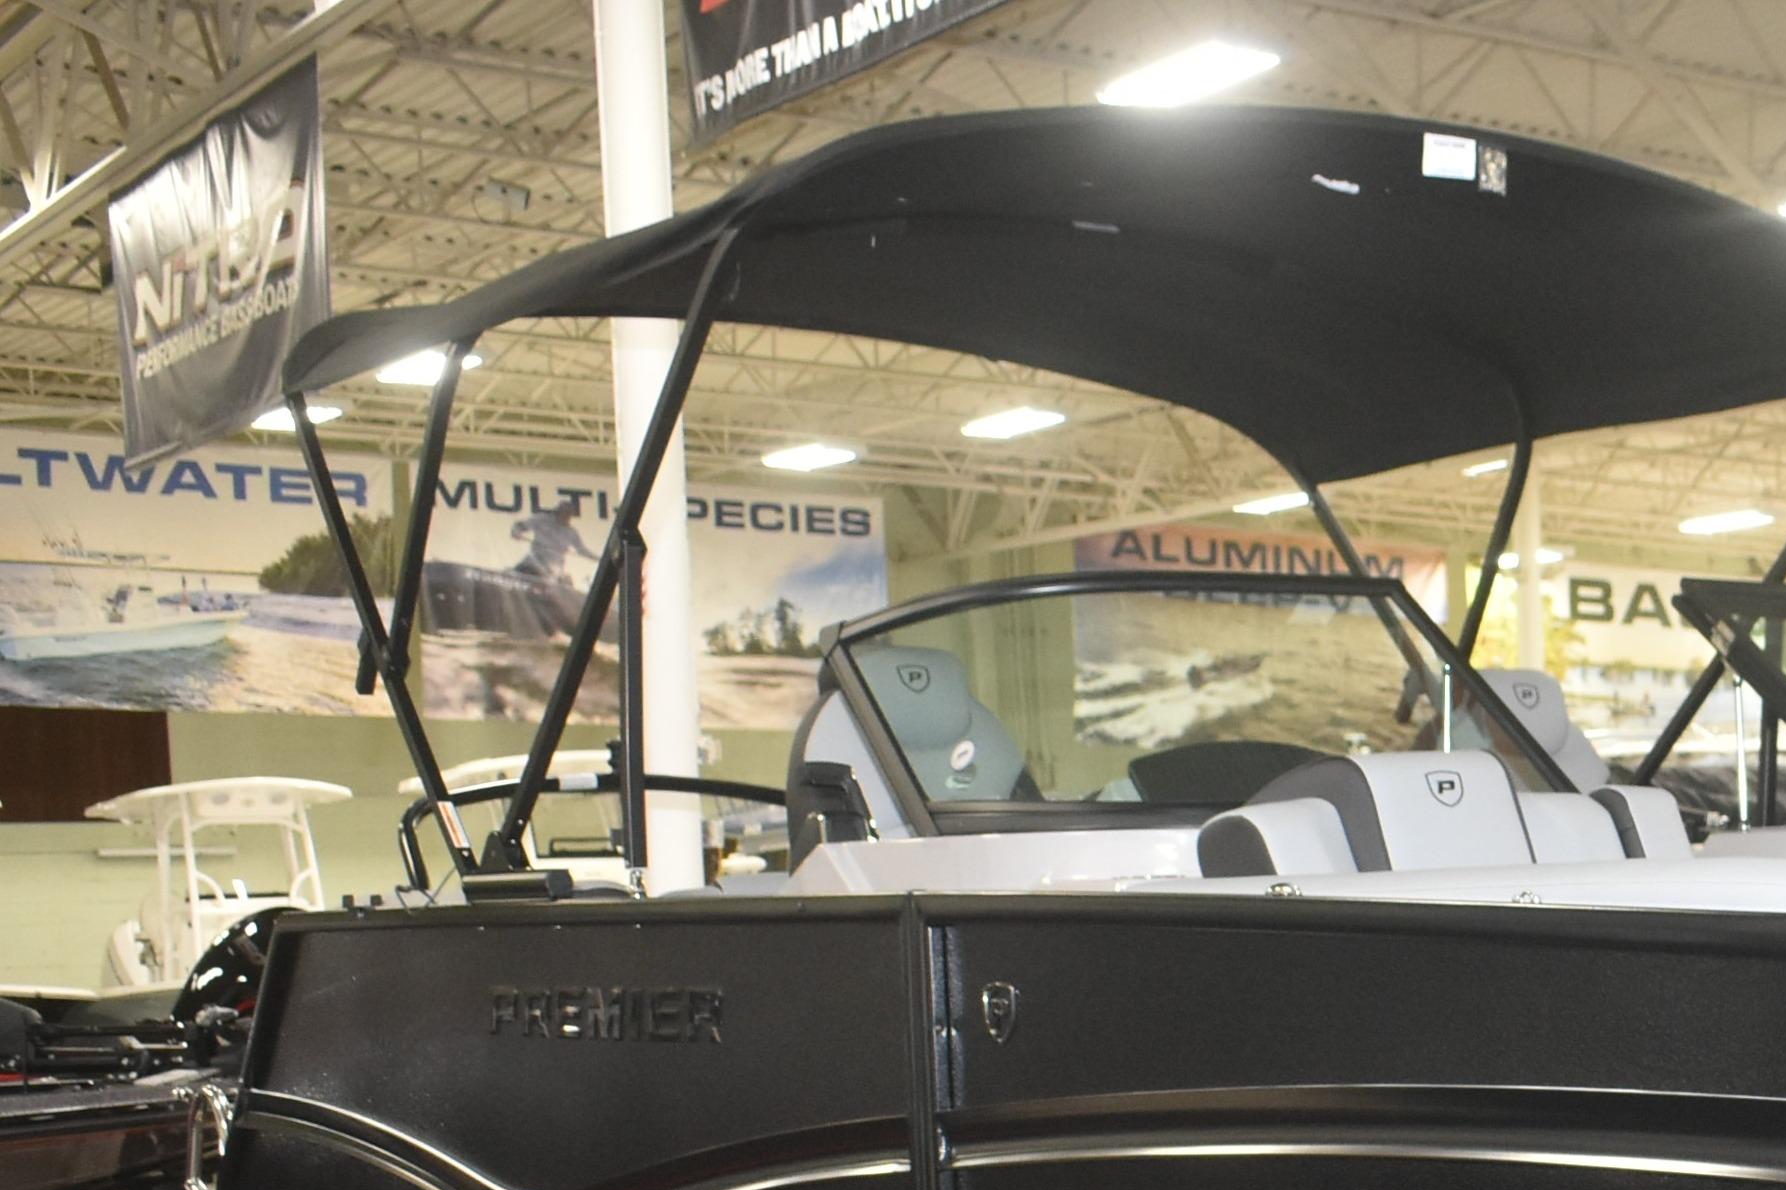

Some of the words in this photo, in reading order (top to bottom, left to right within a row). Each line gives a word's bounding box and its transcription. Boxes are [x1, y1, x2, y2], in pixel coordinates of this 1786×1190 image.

[771, 22, 821, 78] THAN
[822, 15, 839, 53] A
[488, 983, 722, 1044] PREMIER
